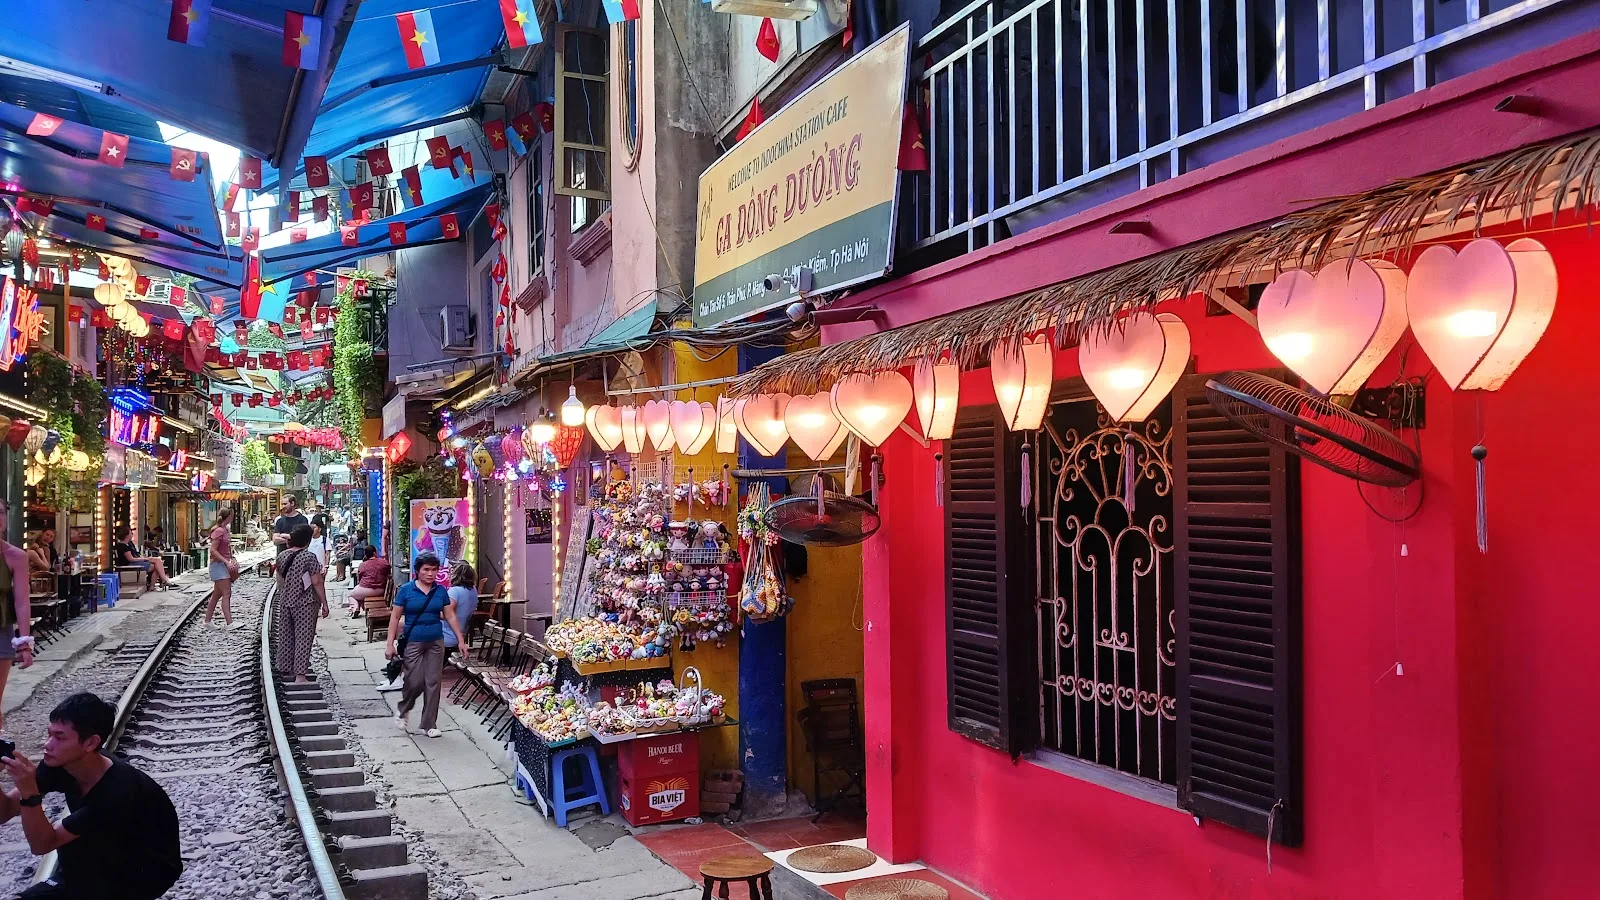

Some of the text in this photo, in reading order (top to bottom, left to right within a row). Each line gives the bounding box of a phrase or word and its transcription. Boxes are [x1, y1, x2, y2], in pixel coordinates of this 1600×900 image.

[728, 95, 849, 193] WELCOME TO INDOCHINA STATION CAFE
[716, 212, 732, 258] GA
[830, 248, 840, 274] Tp
[841, 243, 853, 265] Hà
[853, 238, 870, 263] Nội
[648, 743, 683, 757] HANOI BEER
[652, 792, 683, 805] BIA VIỆT
